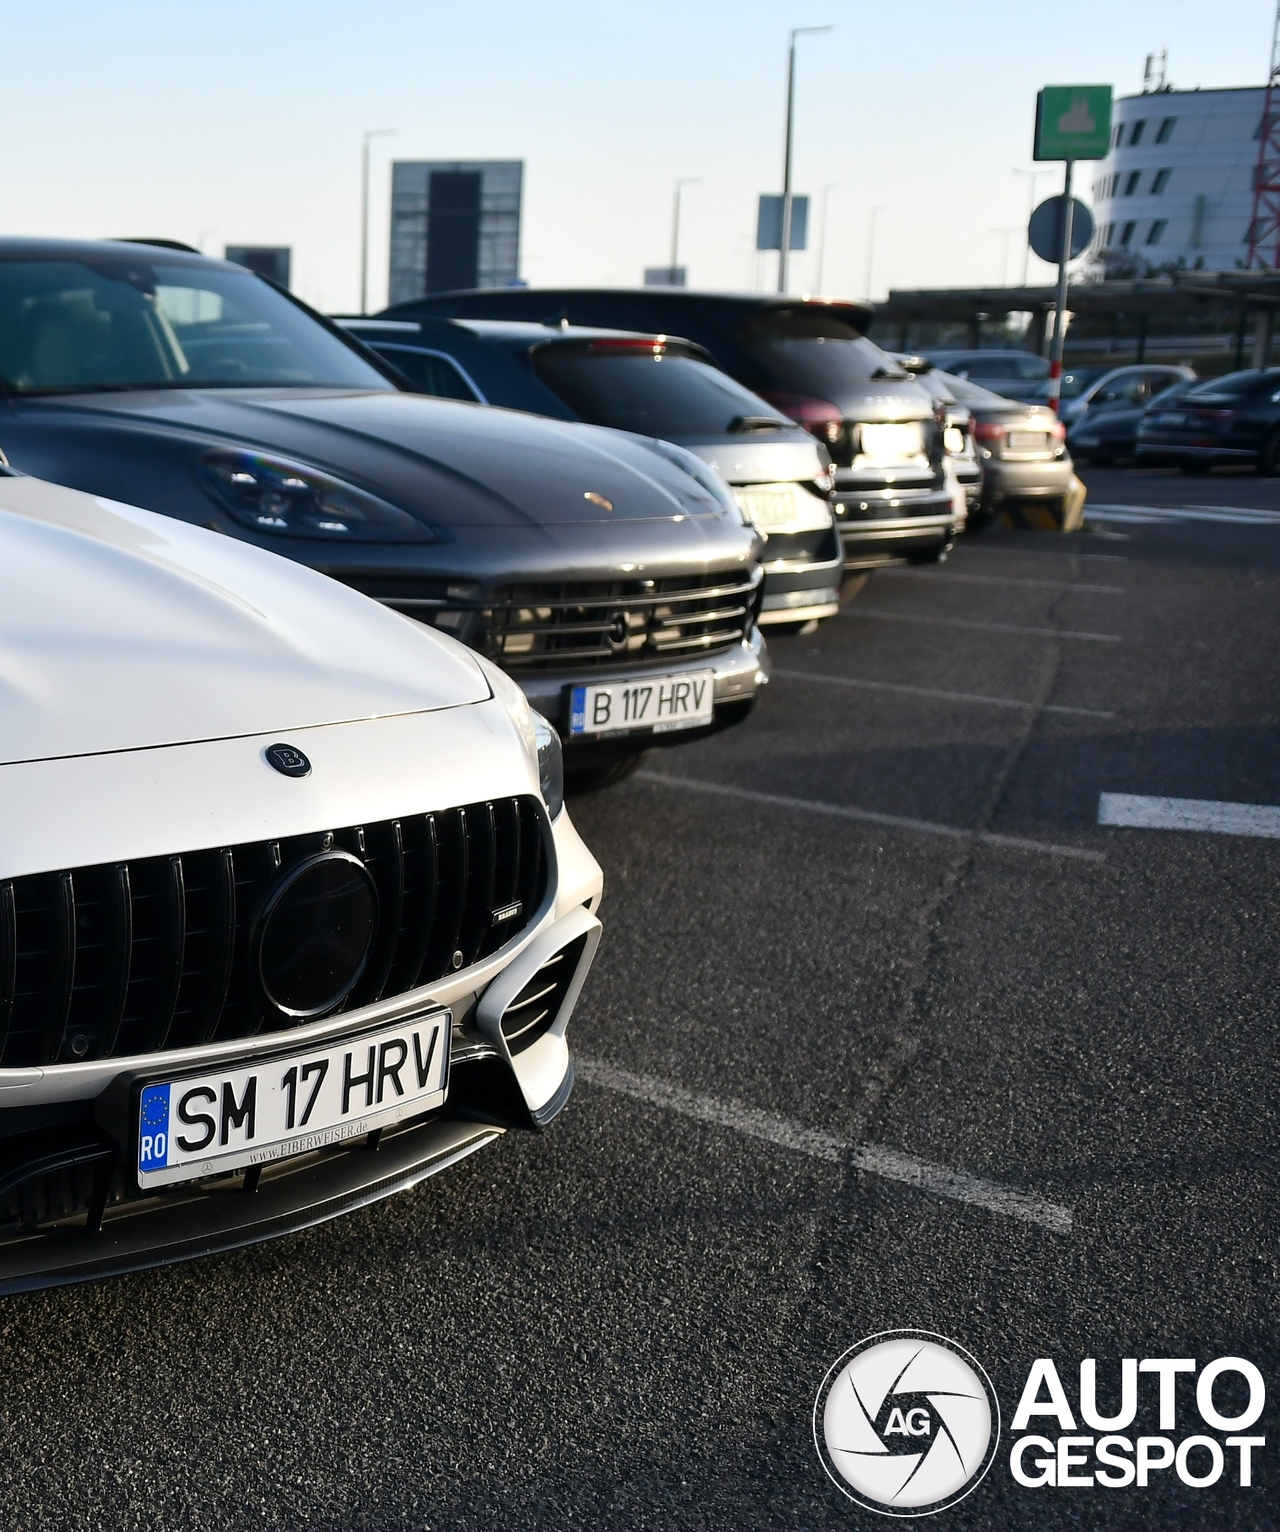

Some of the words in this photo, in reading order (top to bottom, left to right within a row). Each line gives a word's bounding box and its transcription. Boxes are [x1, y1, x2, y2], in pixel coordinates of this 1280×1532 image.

[593, 692, 611, 725] B
[622, 687, 653, 721] 117
[657, 680, 706, 716] HRV
[273, 748, 305, 769] B
[176, 1075, 257, 1152] SM
[281, 1058, 329, 1131] 17
[341, 1025, 439, 1115] HRV
[141, 1132, 166, 1162] RO
[249, 1122, 368, 1164] www.EIBERWEISER.de
